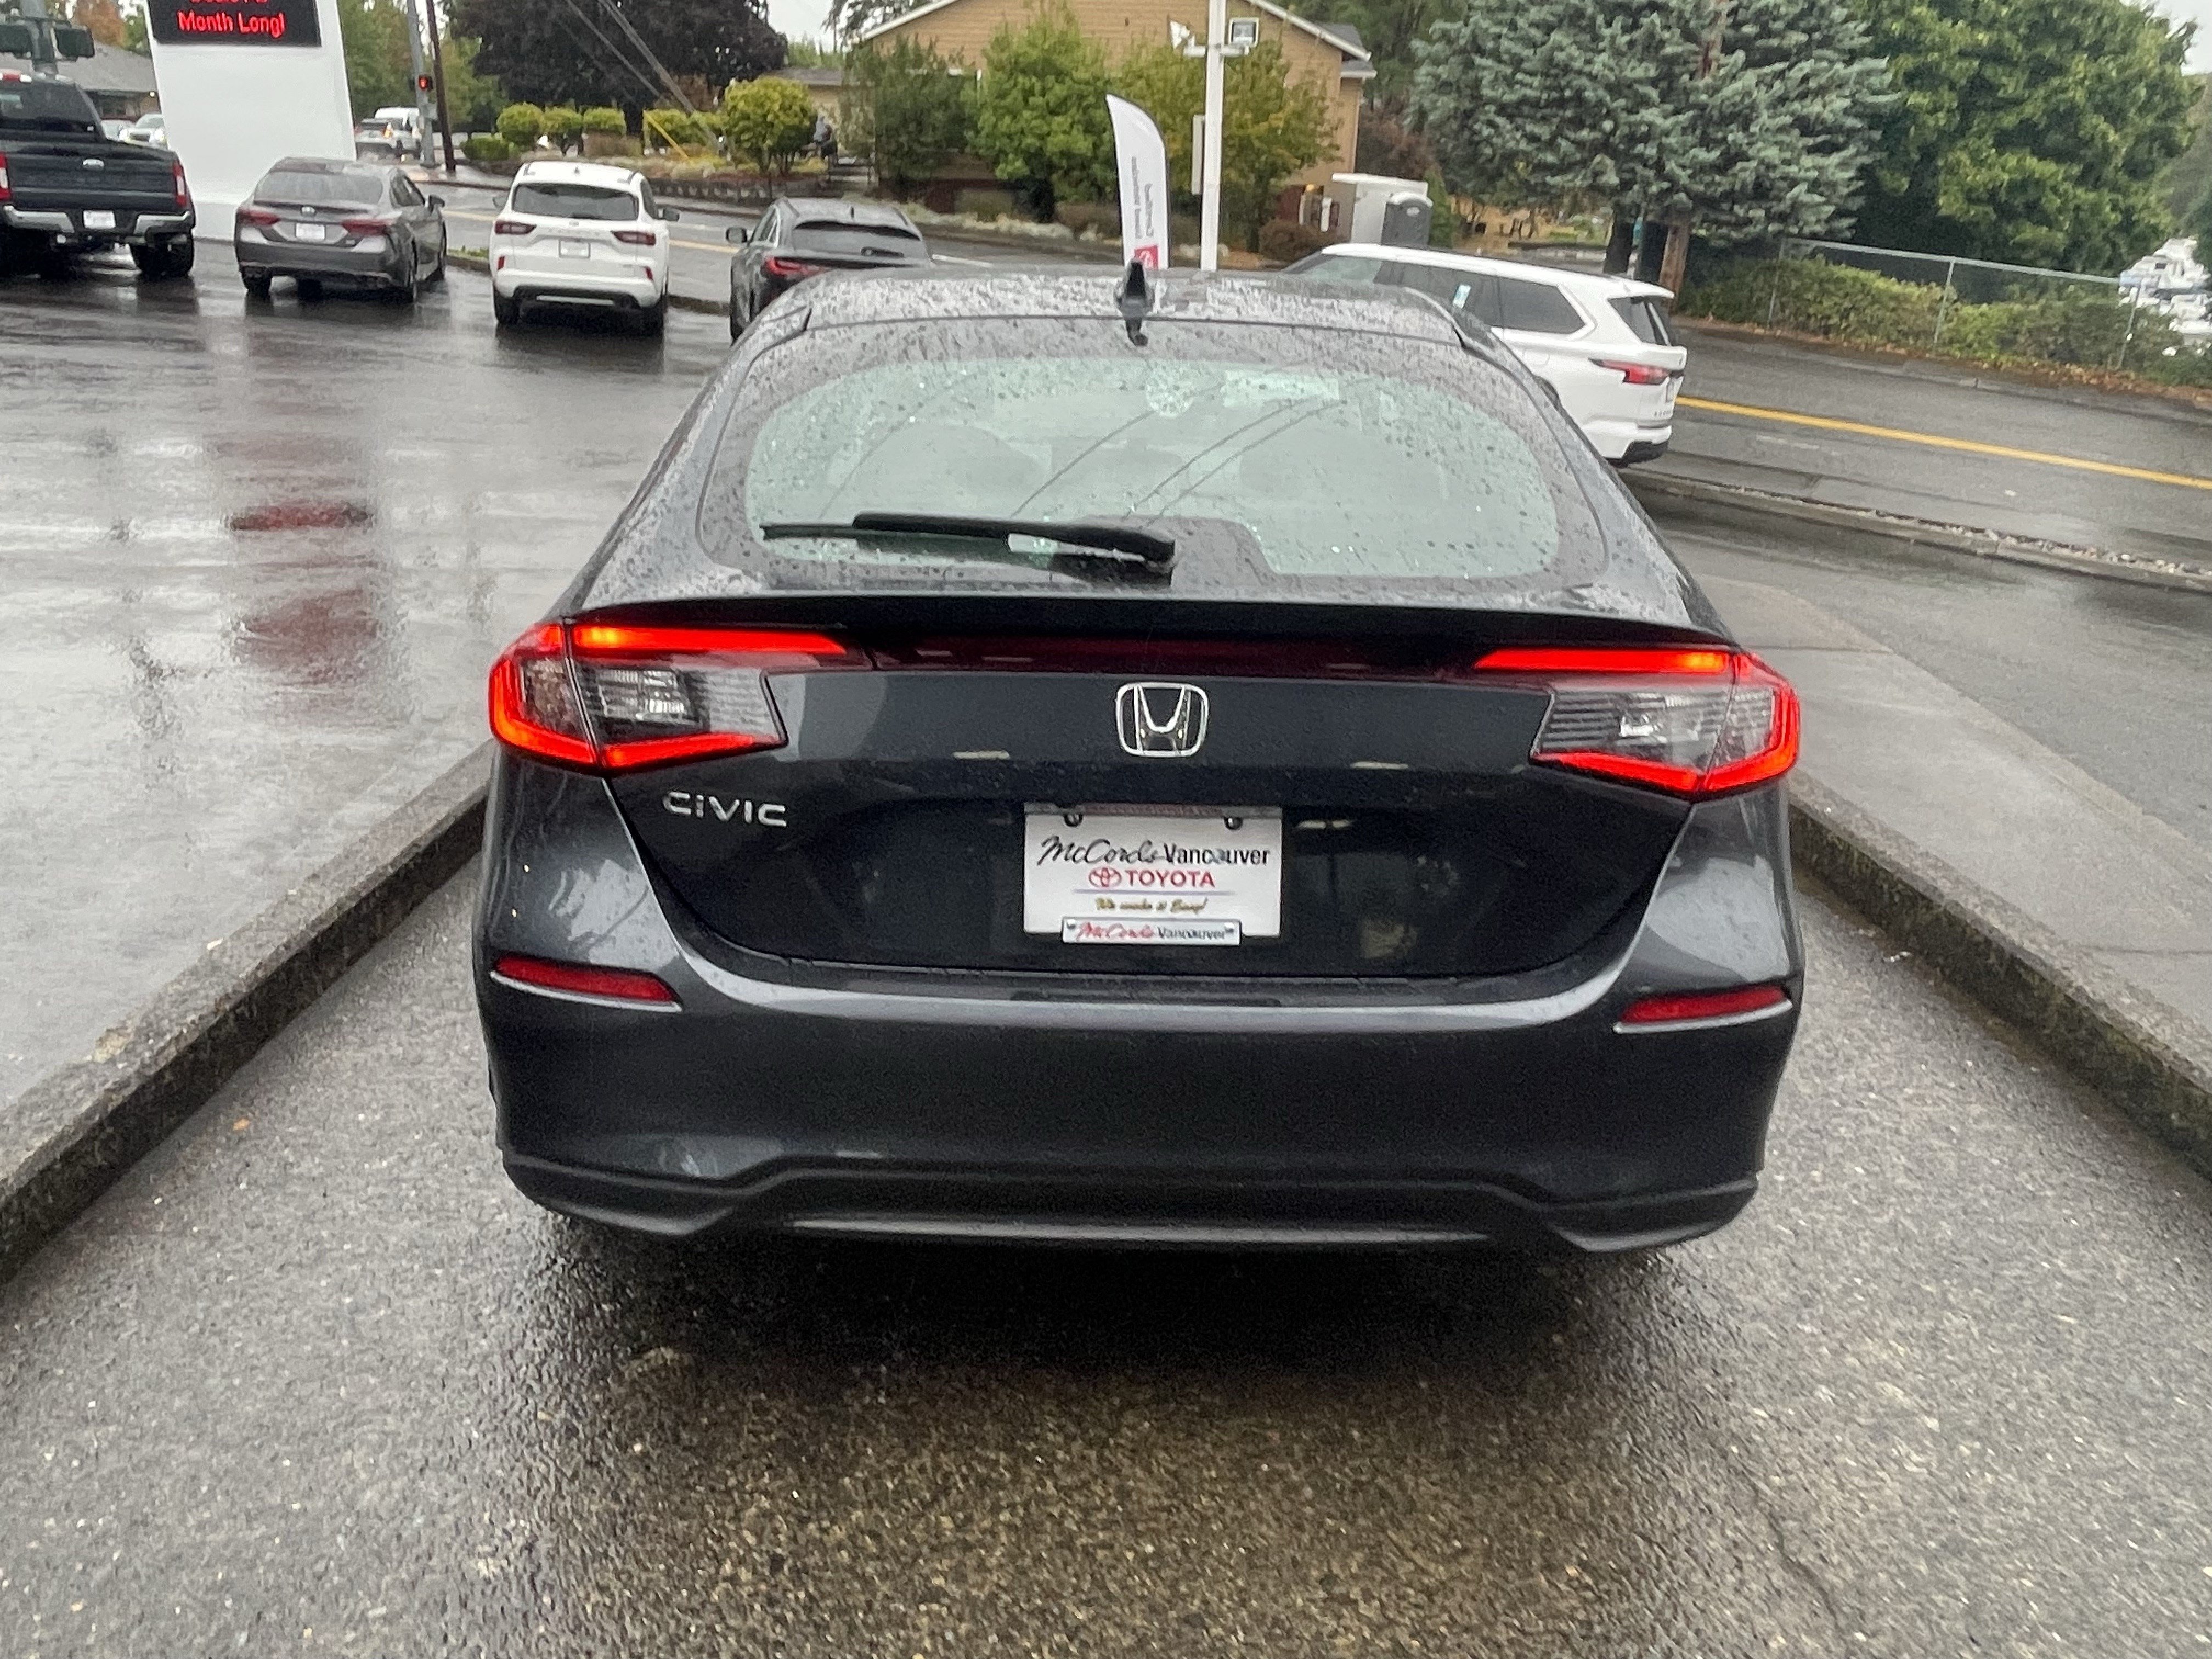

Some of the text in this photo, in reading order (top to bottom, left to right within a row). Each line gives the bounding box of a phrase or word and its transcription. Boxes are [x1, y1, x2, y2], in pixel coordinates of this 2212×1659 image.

[177, 9, 234, 32] Month
[663, 791, 787, 827] CIVIC
[1163, 843, 1271, 866] Vancouver
[1125, 869, 1215, 888] TOYOTA
